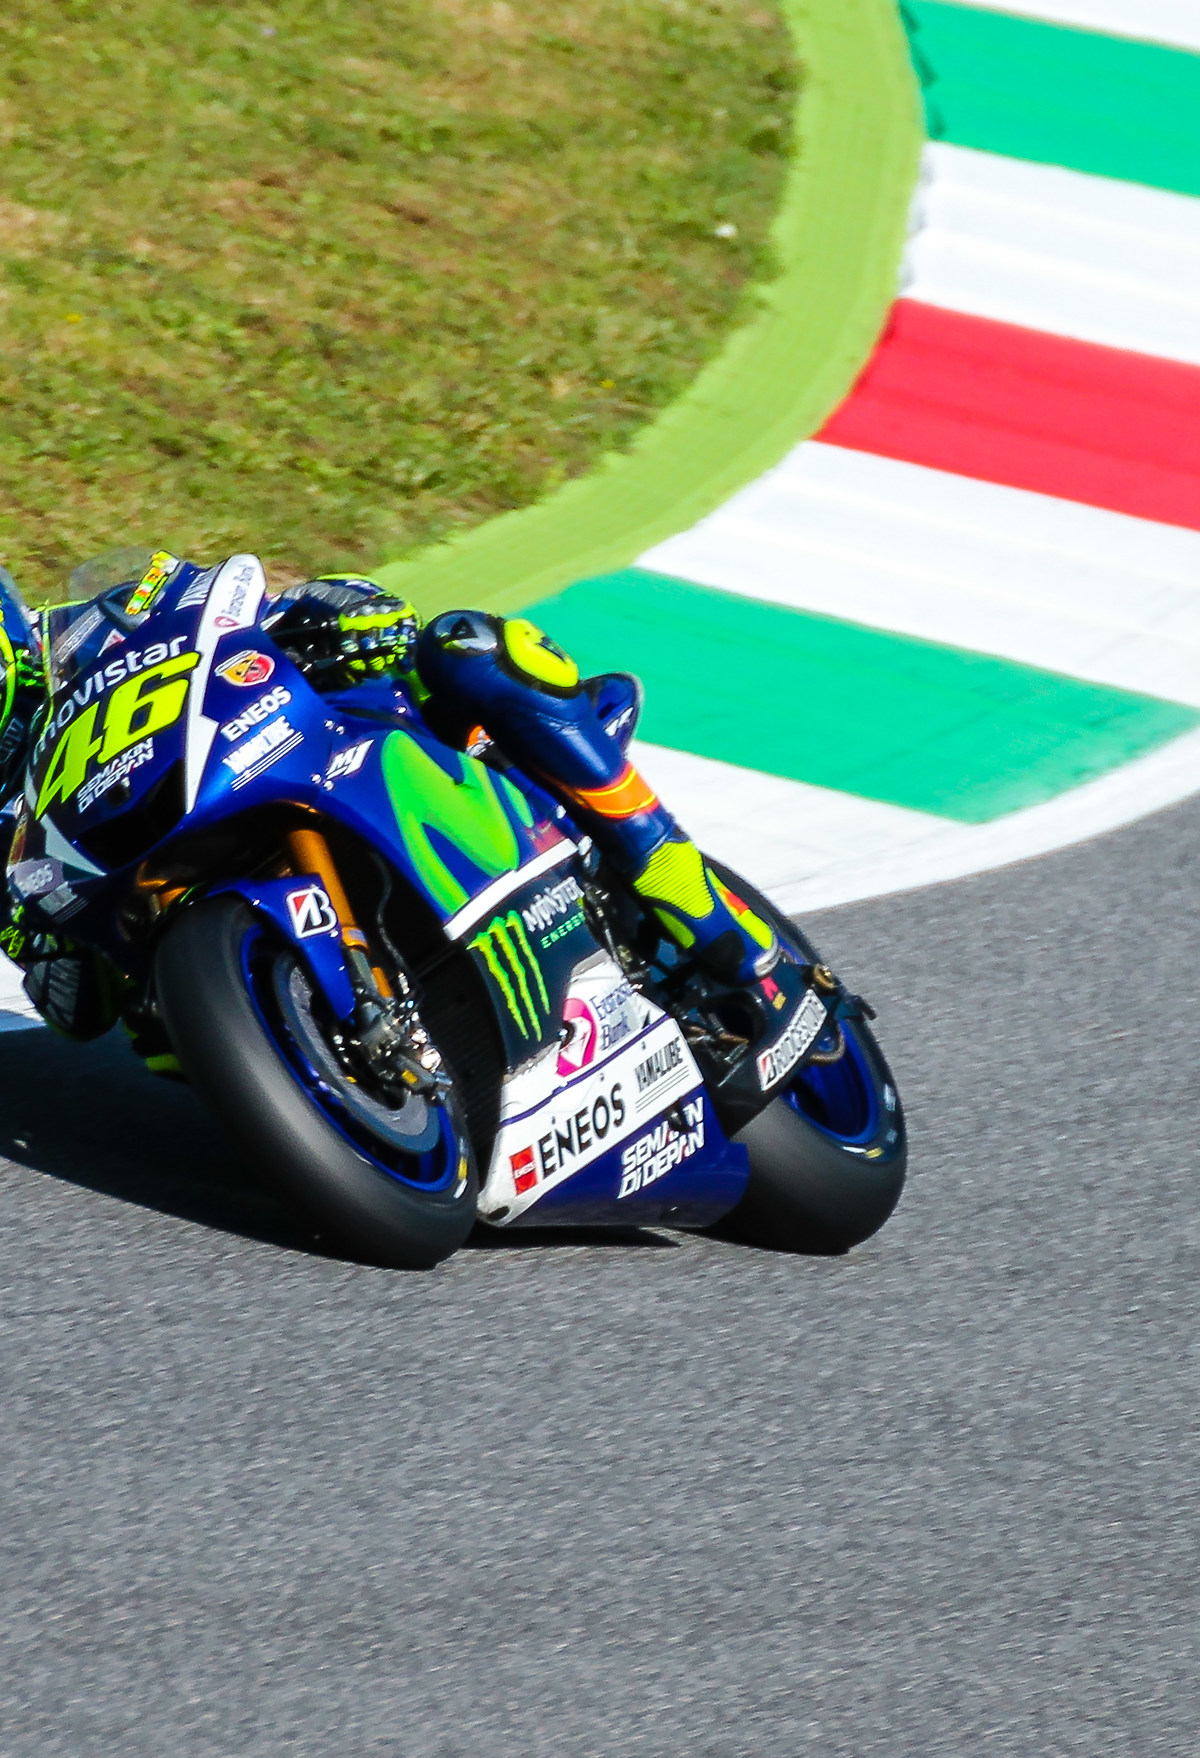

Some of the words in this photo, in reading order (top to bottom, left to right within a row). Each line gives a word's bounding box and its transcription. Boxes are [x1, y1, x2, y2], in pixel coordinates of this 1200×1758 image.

[35, 651, 201, 821] 46
[220, 685, 293, 743] ENEOS
[77, 736, 155, 800] SEMAKIN
[77, 787, 97, 814] DI
[94, 746, 156, 803] DEPAN
[521, 875, 586, 933] MONSTER
[537, 1081, 626, 1180] ENEOS
[615, 1165, 645, 1200] DI
[641, 1122, 705, 1186] DEPAN
